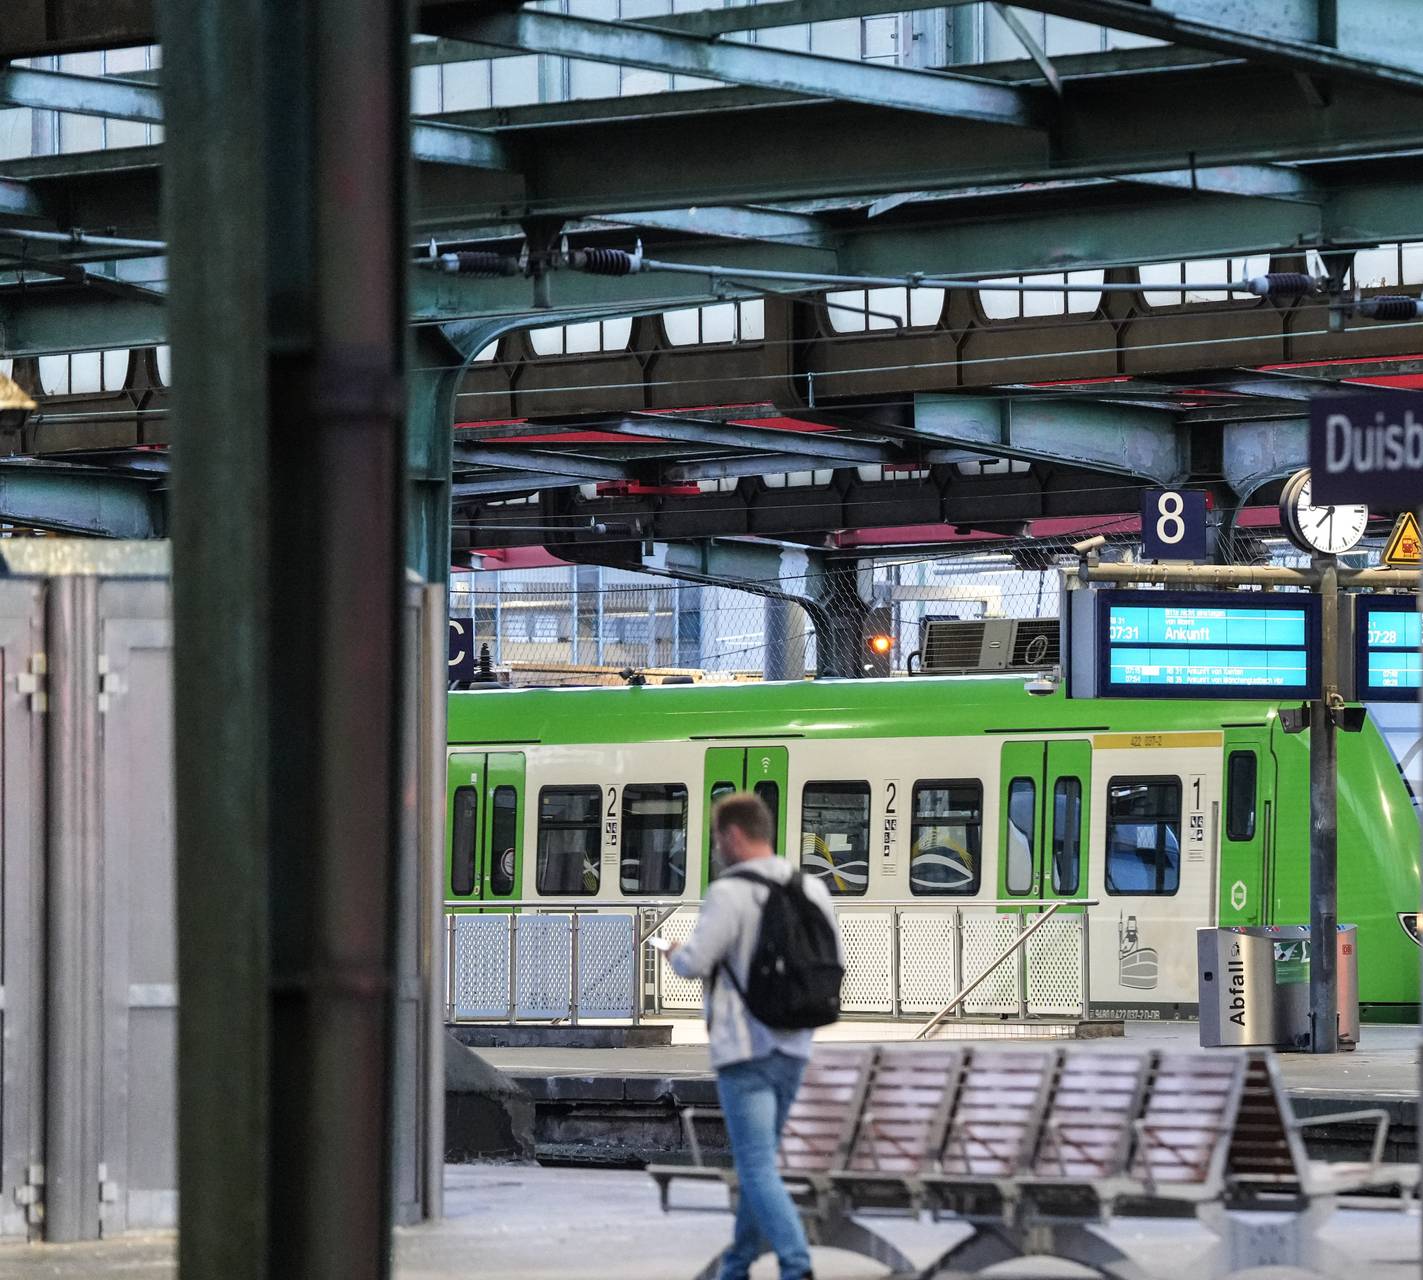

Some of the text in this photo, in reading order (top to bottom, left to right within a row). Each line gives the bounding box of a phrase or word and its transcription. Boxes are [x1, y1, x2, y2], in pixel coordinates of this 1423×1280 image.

[1156, 492, 1186, 545] 8
[1110, 626, 1138, 640] 07:31
[1165, 626, 1210, 641] Ankunft
[607, 787, 616, 817] 2
[886, 782, 896, 814] 2
[1193, 777, 1201, 810] 1
[1228, 961, 1246, 1026] Abfall
